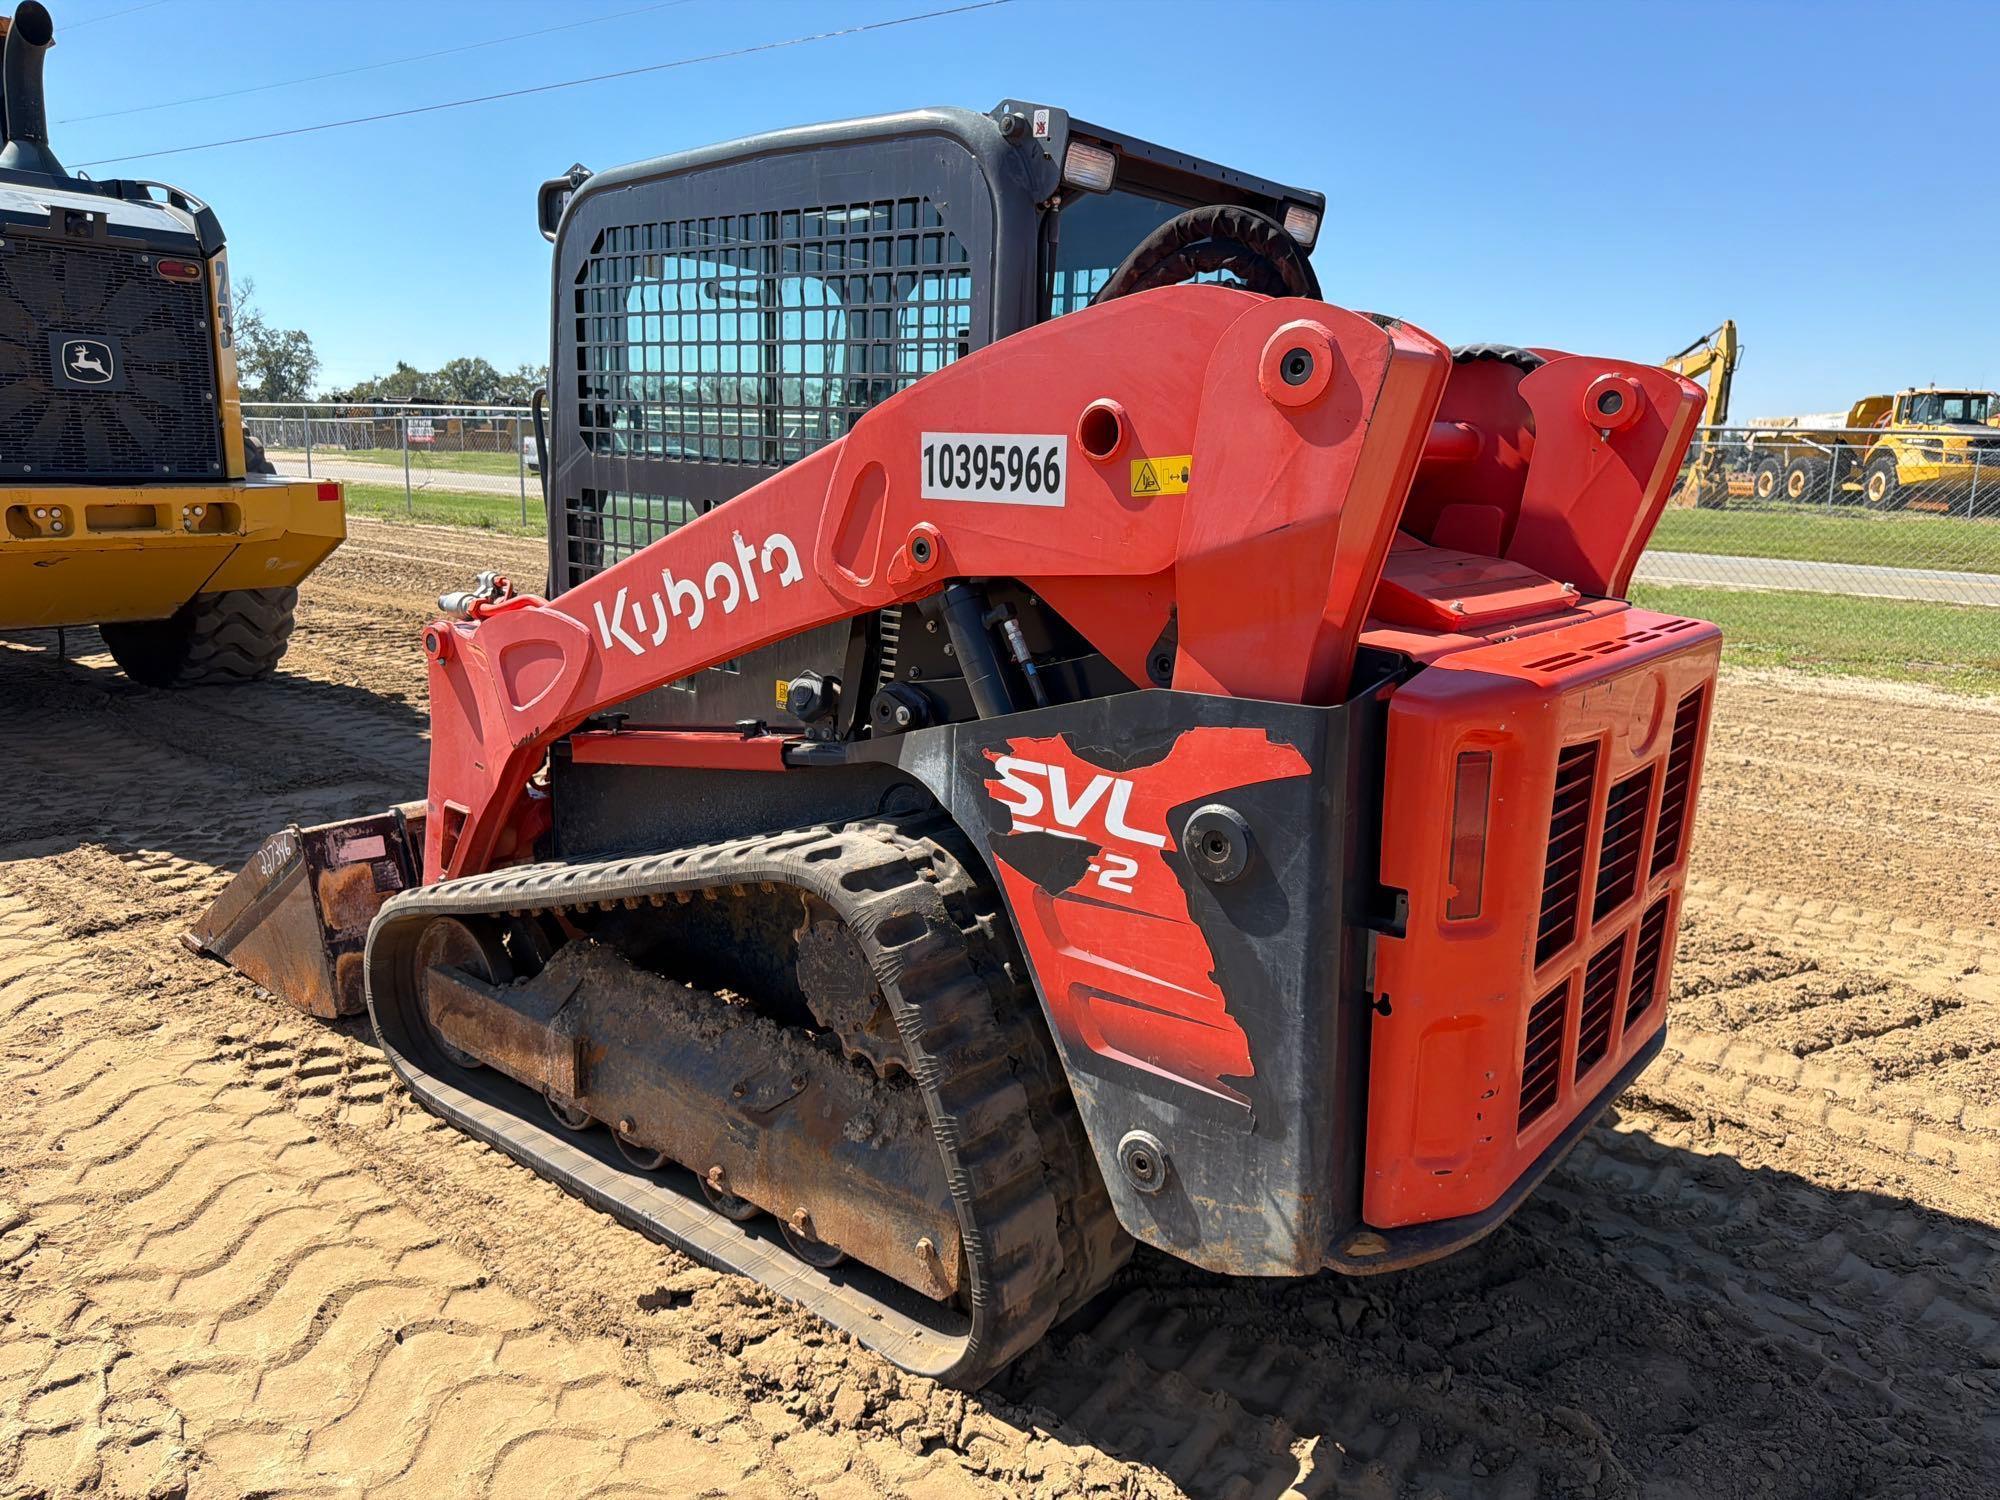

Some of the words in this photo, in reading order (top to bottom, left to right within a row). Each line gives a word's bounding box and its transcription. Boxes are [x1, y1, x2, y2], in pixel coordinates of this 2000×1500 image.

[923, 443, 1061, 494] 10395966
[593, 529, 804, 656] Kubota
[995, 756, 1166, 848] SVL
